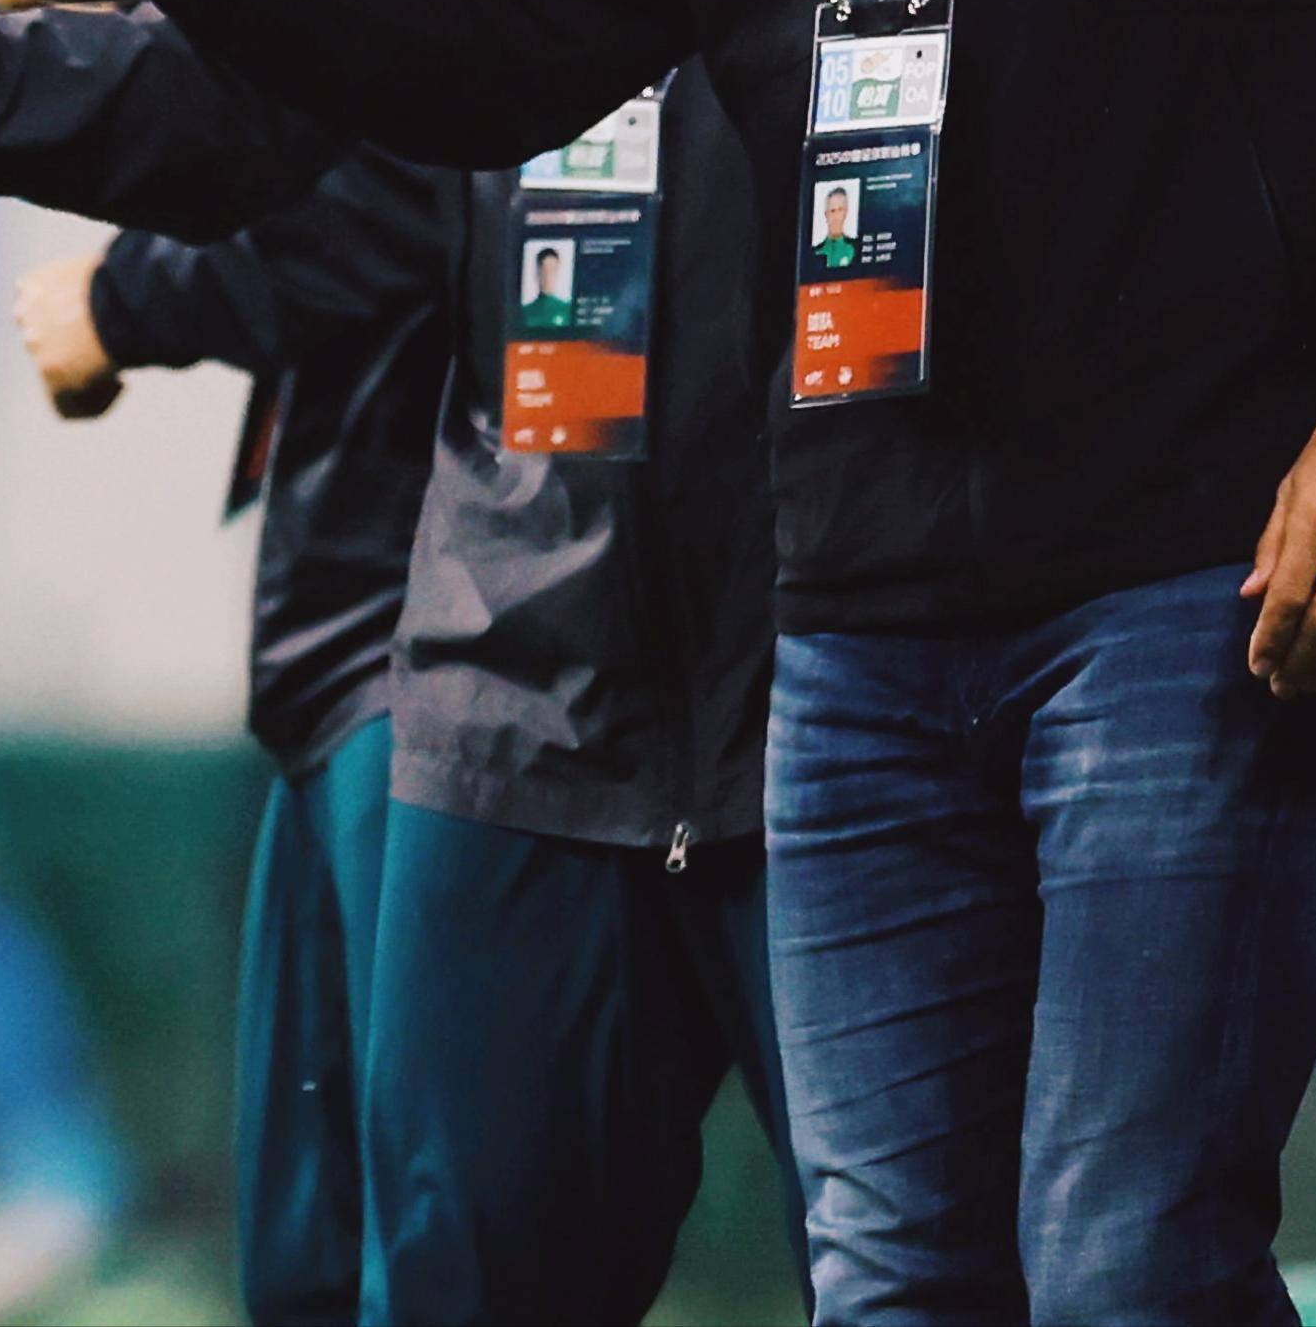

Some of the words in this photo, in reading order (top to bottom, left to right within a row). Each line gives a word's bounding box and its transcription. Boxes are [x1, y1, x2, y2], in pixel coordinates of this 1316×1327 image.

[822, 54, 849, 86] 05
[819, 88, 847, 118] 10
[807, 333, 840, 351] TEAM
